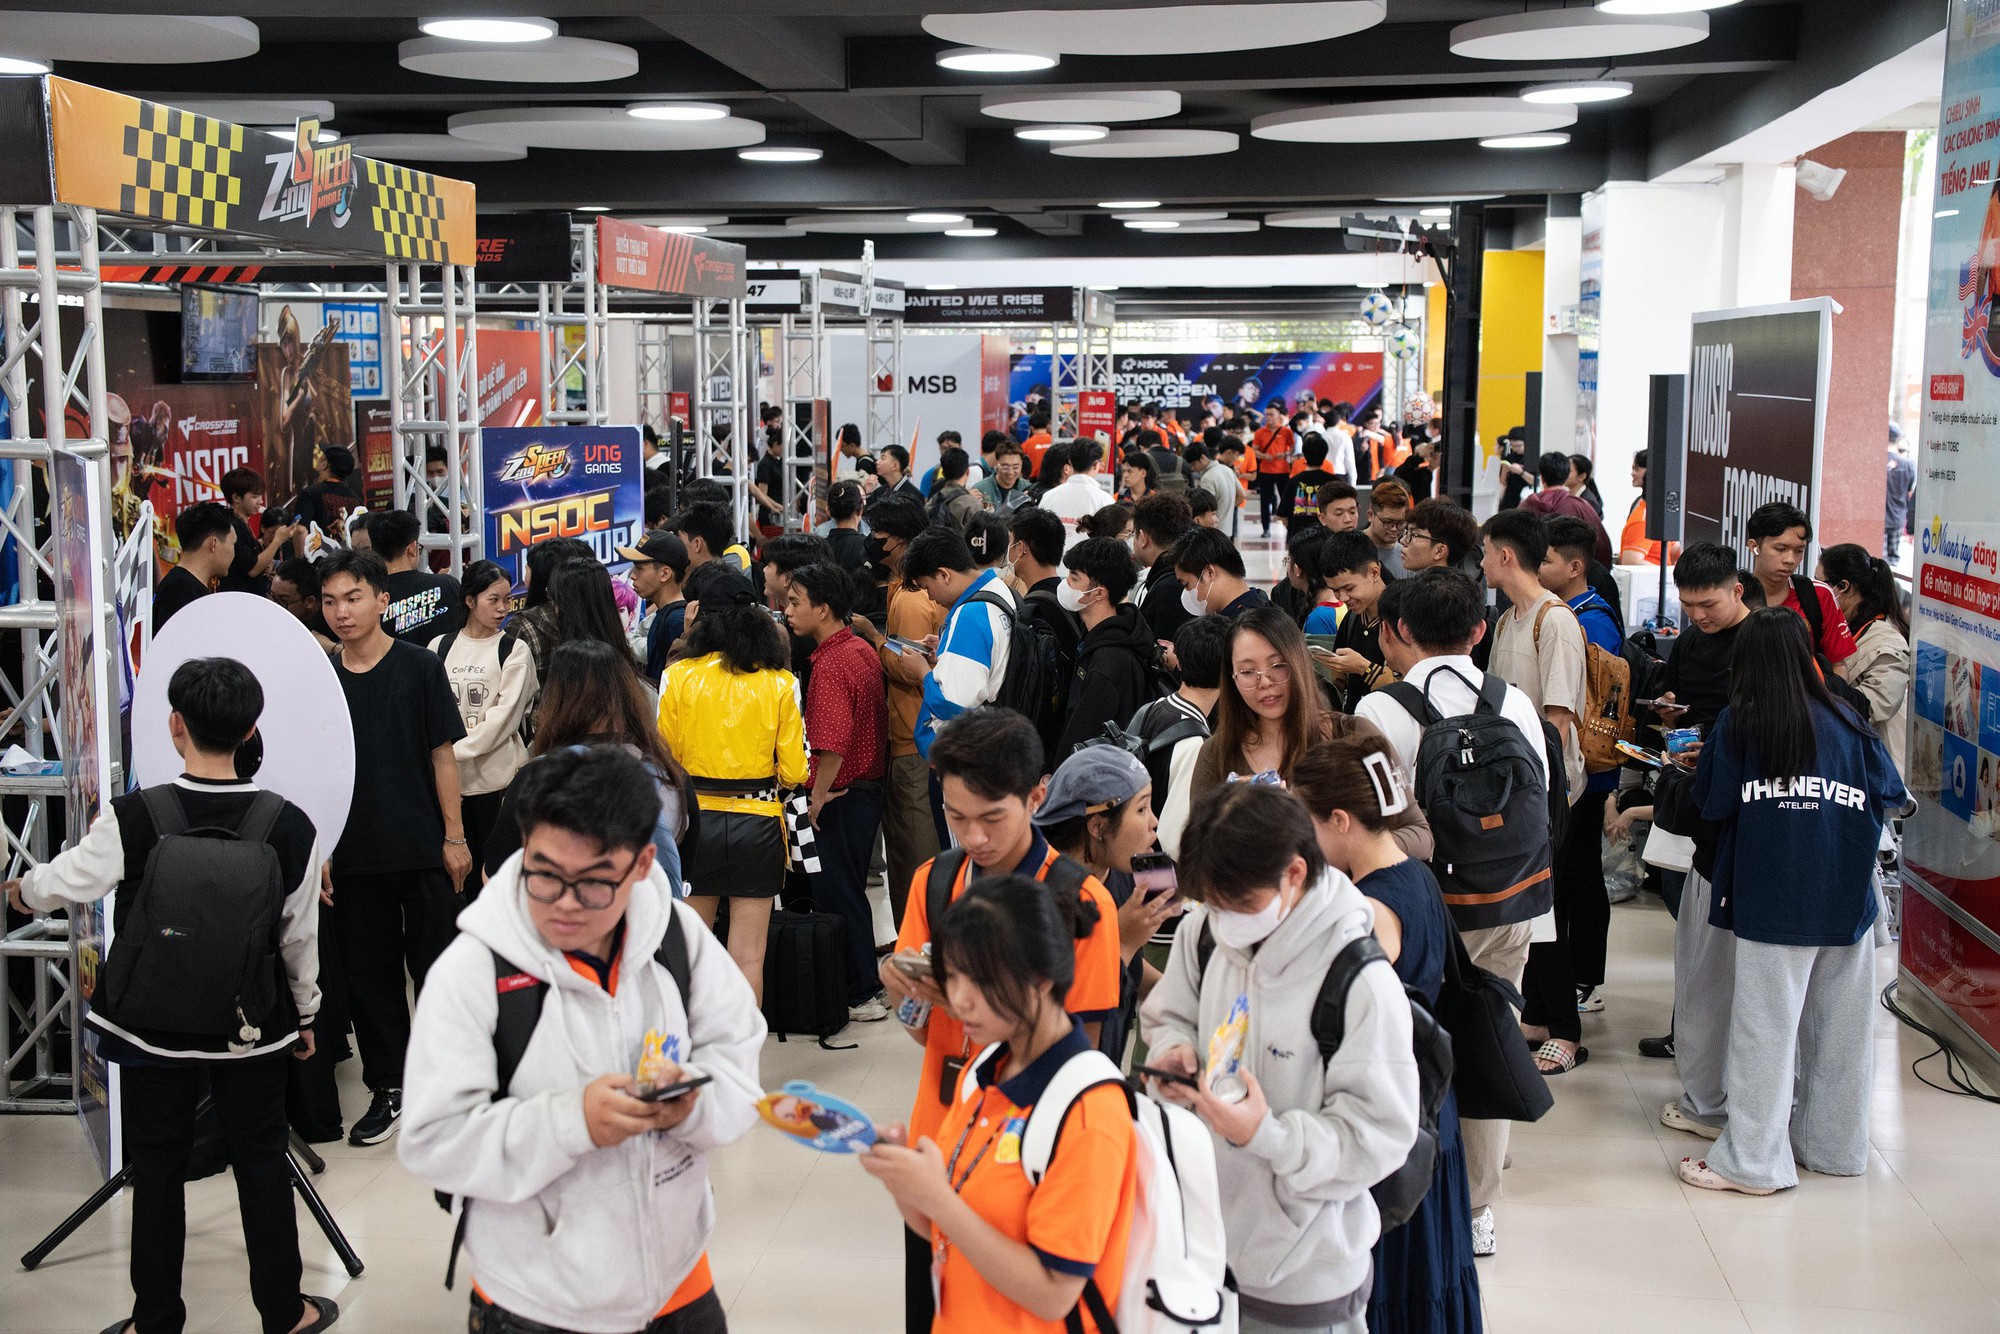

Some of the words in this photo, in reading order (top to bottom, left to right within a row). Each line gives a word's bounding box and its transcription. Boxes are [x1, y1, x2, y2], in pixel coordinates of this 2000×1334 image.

[1946, 99, 1964, 125] CHIÊU
[1965, 95, 1981, 119] SINH
[1941, 160, 1967, 197] TIẾNG
[1968, 159, 1990, 190] ANH
[968, 295, 998, 306] WE
[1003, 294, 1044, 305] RISE
[1137, 361, 1168, 369] NSOC
[908, 375, 957, 394] MSB
[1098, 373, 1192, 386] NATIONAL
[1933, 379, 1948, 395] CHIÊU
[1948, 381, 1960, 395] SINH
[1163, 385, 1217, 397] OPEN
[1690, 342, 1734, 459] MUSIC
[195, 419, 239, 431] CROSSFIRE
[584, 444, 622, 462] VNG
[585, 463, 622, 474] GAMES
[501, 493, 610, 551] NSOC
[1973, 540, 1997, 575] đăng
[1924, 567, 1933, 589] để
[1934, 575, 1952, 599] nhận
[1953, 582, 1962, 599] ưu
[1963, 582, 1976, 603] đãi
[1976, 586, 1991, 612] học
[382, 586, 442, 623] ZINGSPEED
[394, 602, 437, 632] MOBILE
[1777, 801, 1819, 810] ATELIER
